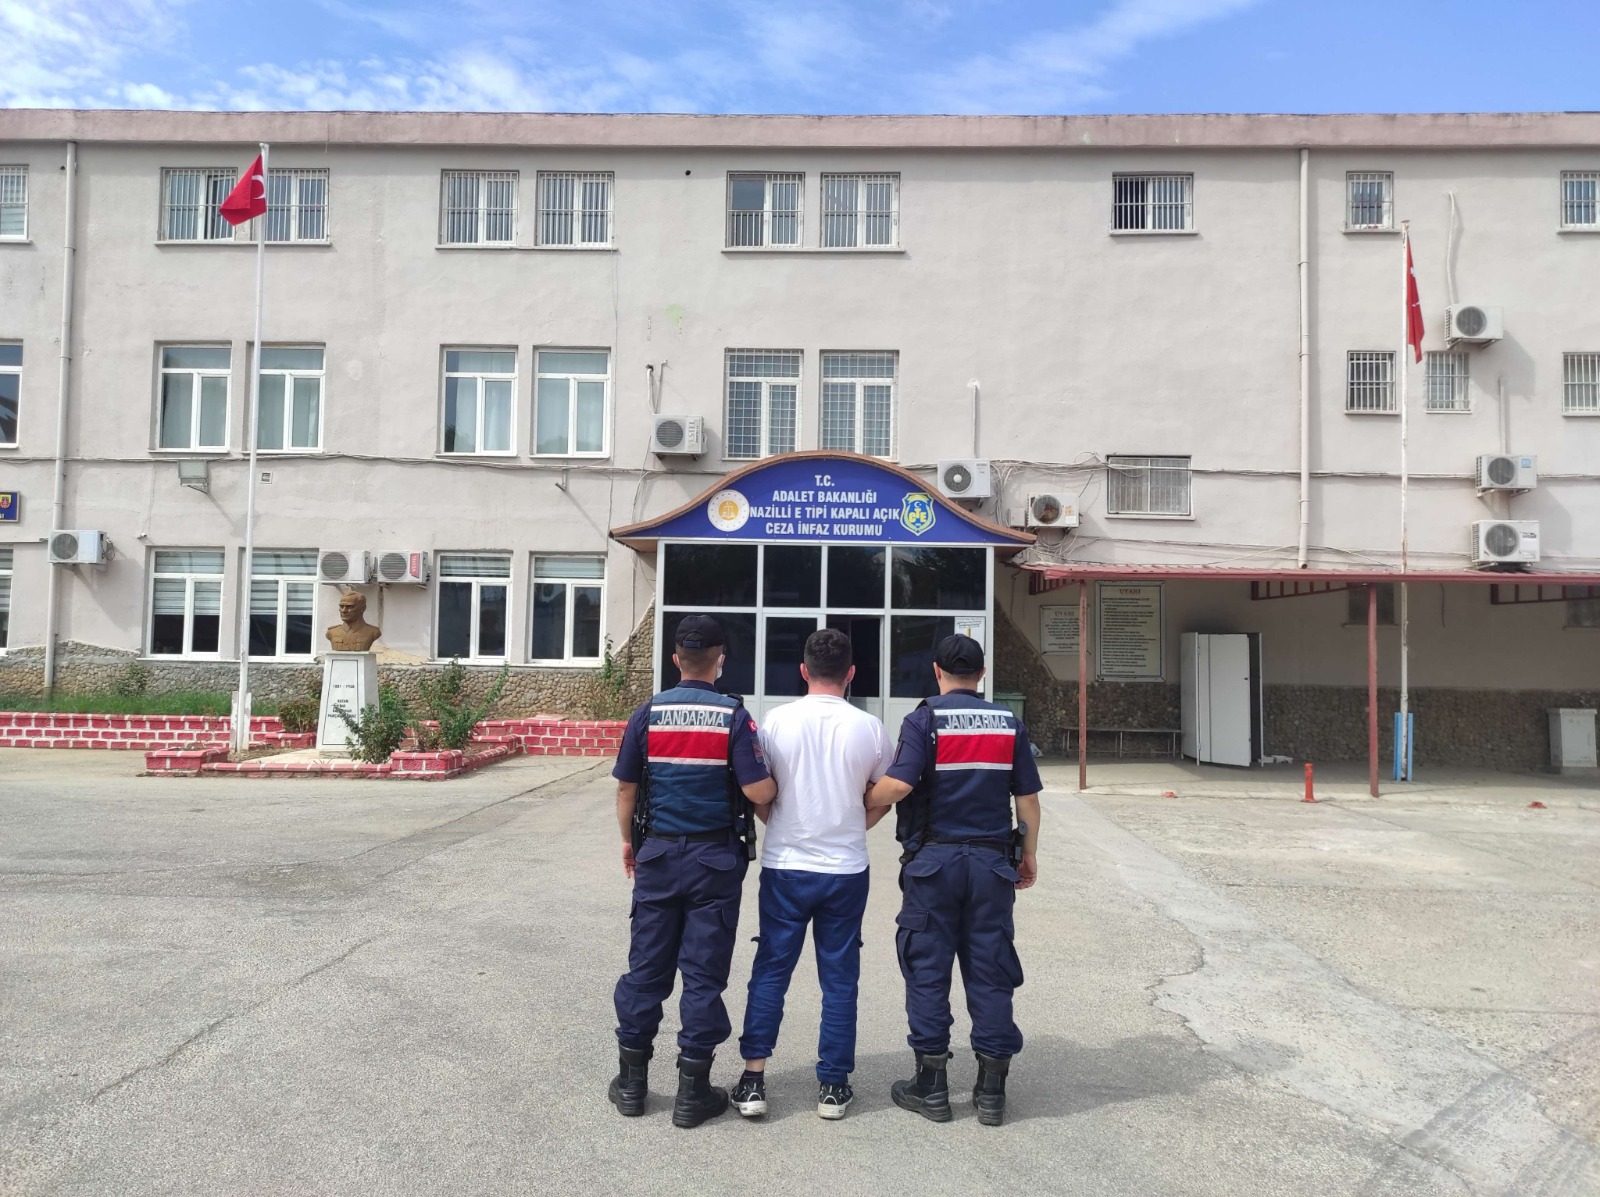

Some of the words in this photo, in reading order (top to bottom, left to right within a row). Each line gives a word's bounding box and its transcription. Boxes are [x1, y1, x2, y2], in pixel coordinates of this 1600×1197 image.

[814, 474, 835, 487] T.C.
[772, 490, 815, 503] ADALET
[817, 490, 877, 503] BAKANLIĞI
[749, 505, 791, 519] NAZİLLİ
[794, 507, 801, 519] E
[805, 505, 827, 519] TİPİ
[830, 507, 869, 520] KAPALI
[872, 507, 900, 522] AÇIK
[765, 523, 794, 535] CEZA
[797, 520, 830, 535] İNFAZ
[833, 523, 883, 536] KURUMU
[657, 709, 725, 727] JANDARMA
[944, 714, 1009, 729] JANDARMA
